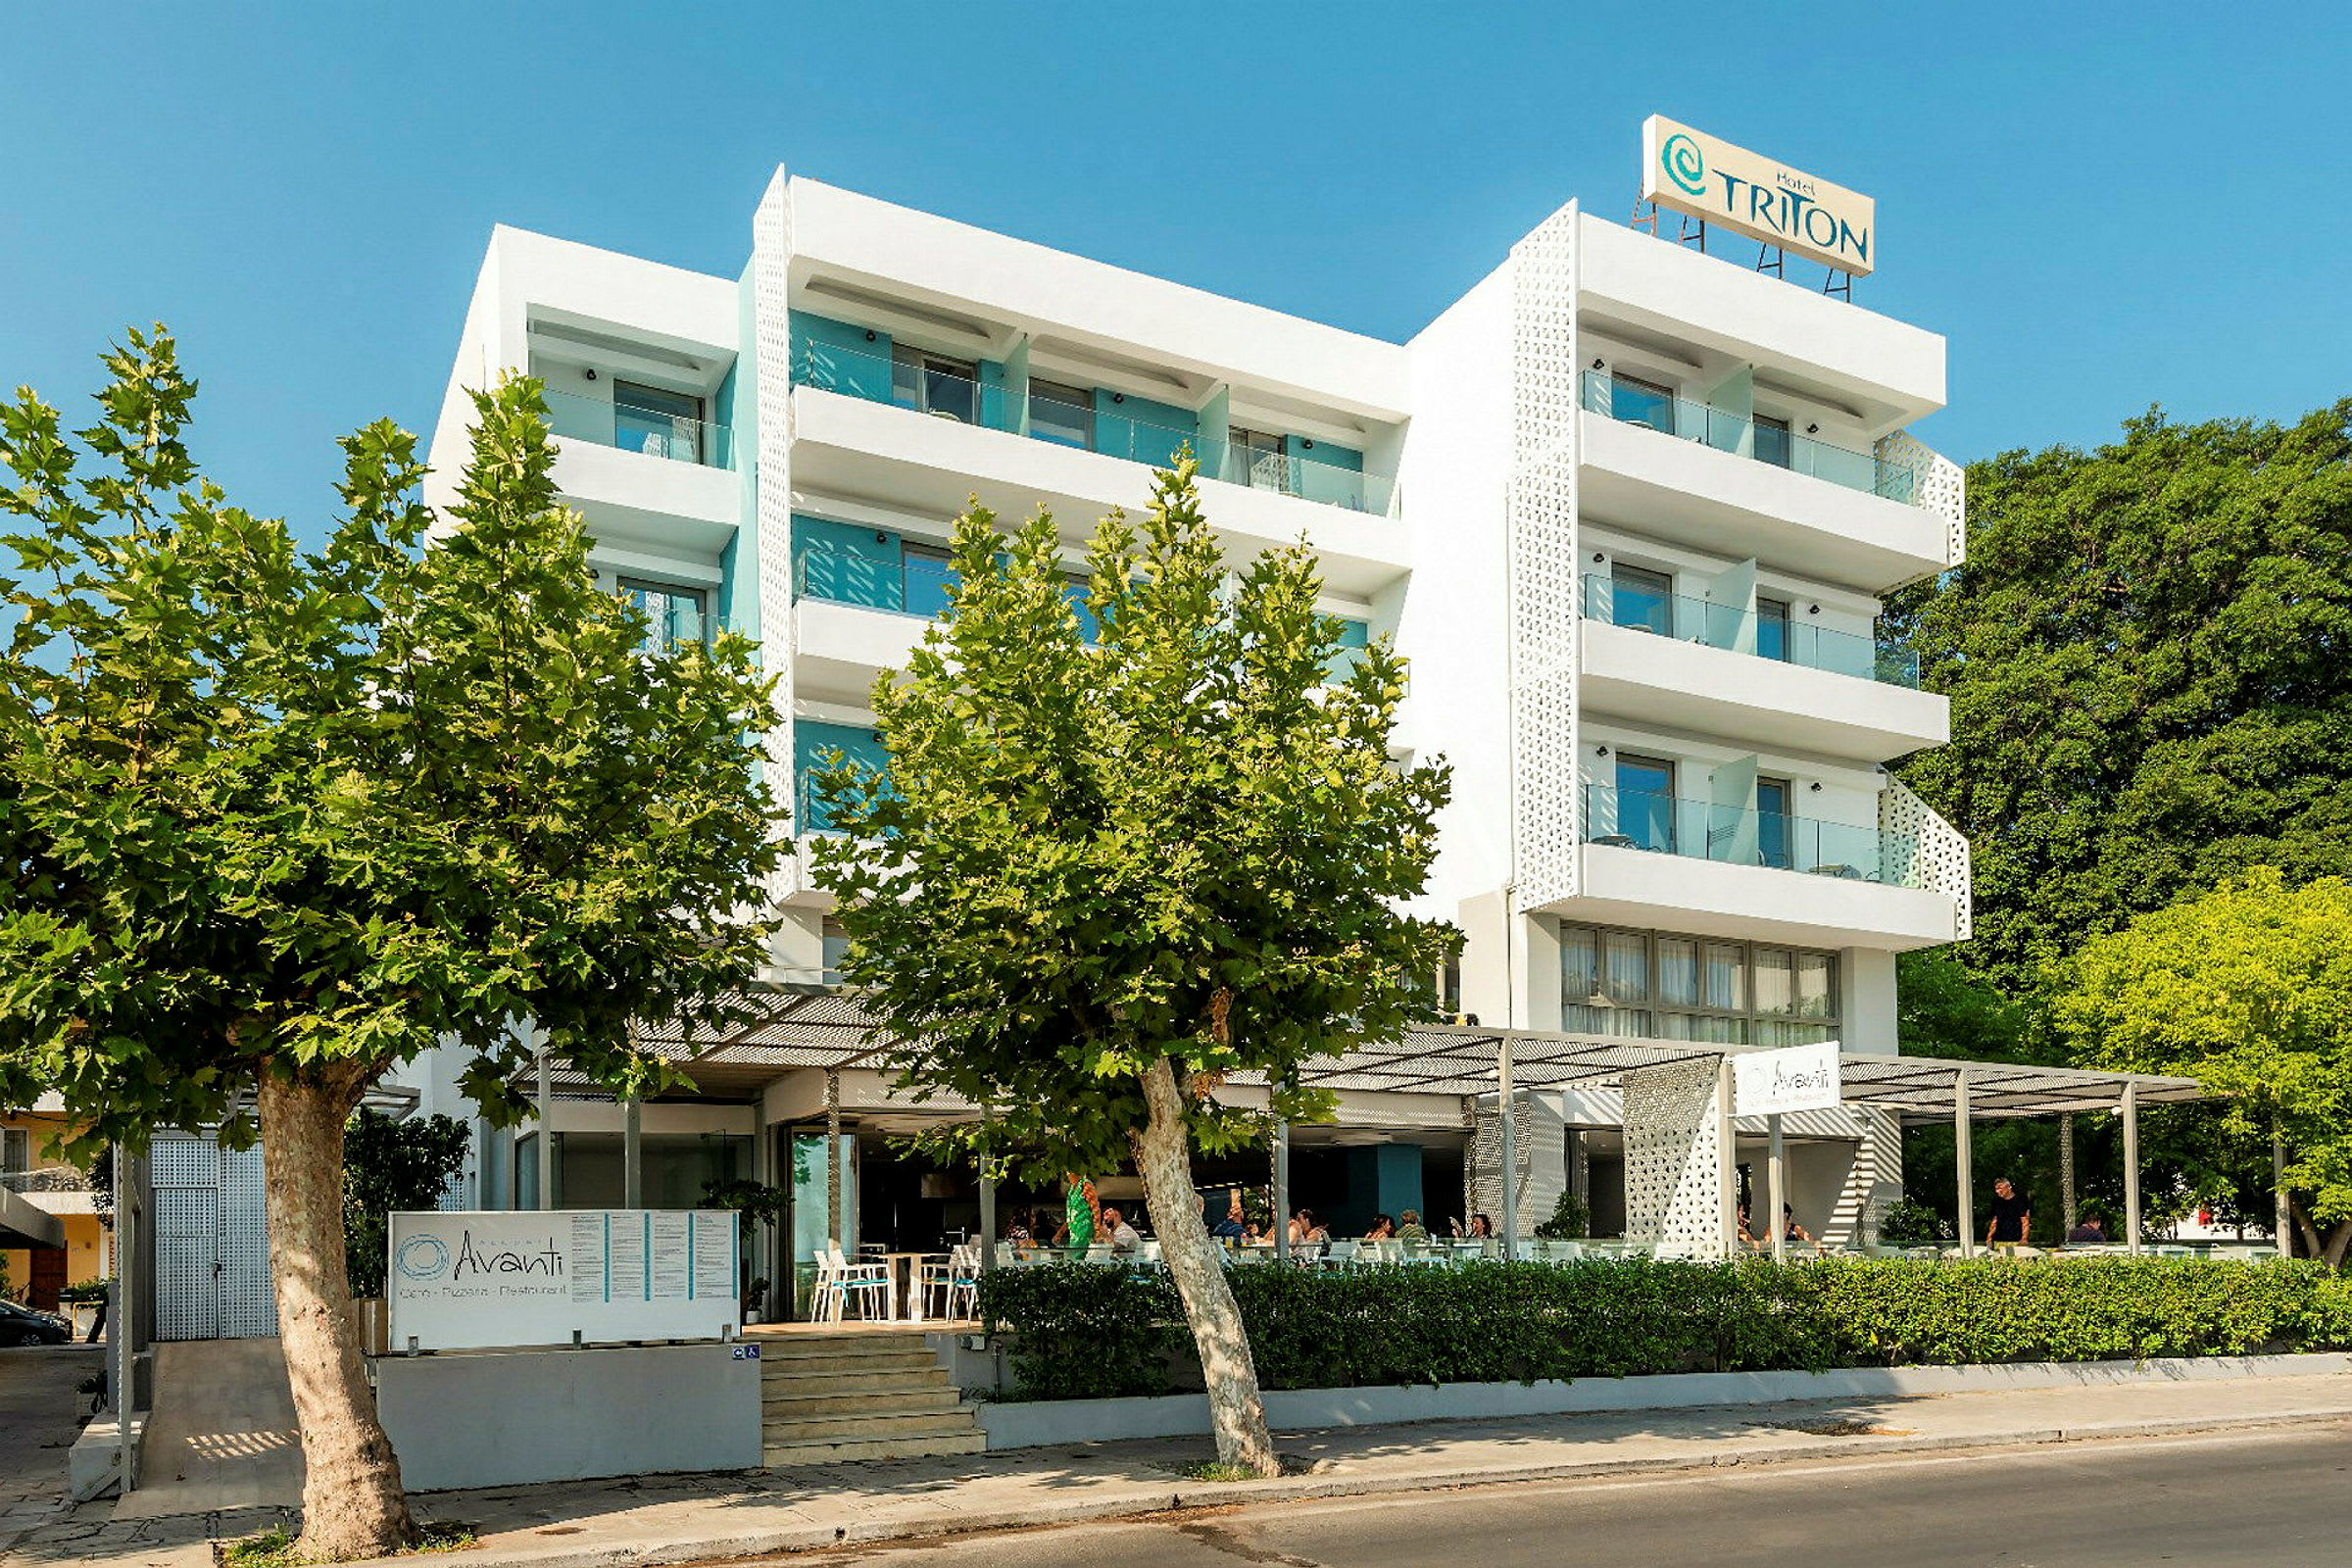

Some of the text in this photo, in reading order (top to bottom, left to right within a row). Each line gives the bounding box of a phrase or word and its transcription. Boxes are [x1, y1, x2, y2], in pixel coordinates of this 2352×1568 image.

[1777, 171, 1815, 195] Hotel
[1711, 169, 1867, 263] TRITON
[1773, 1058, 1829, 1096] Avanti
[454, 1230, 563, 1281] Avanti
